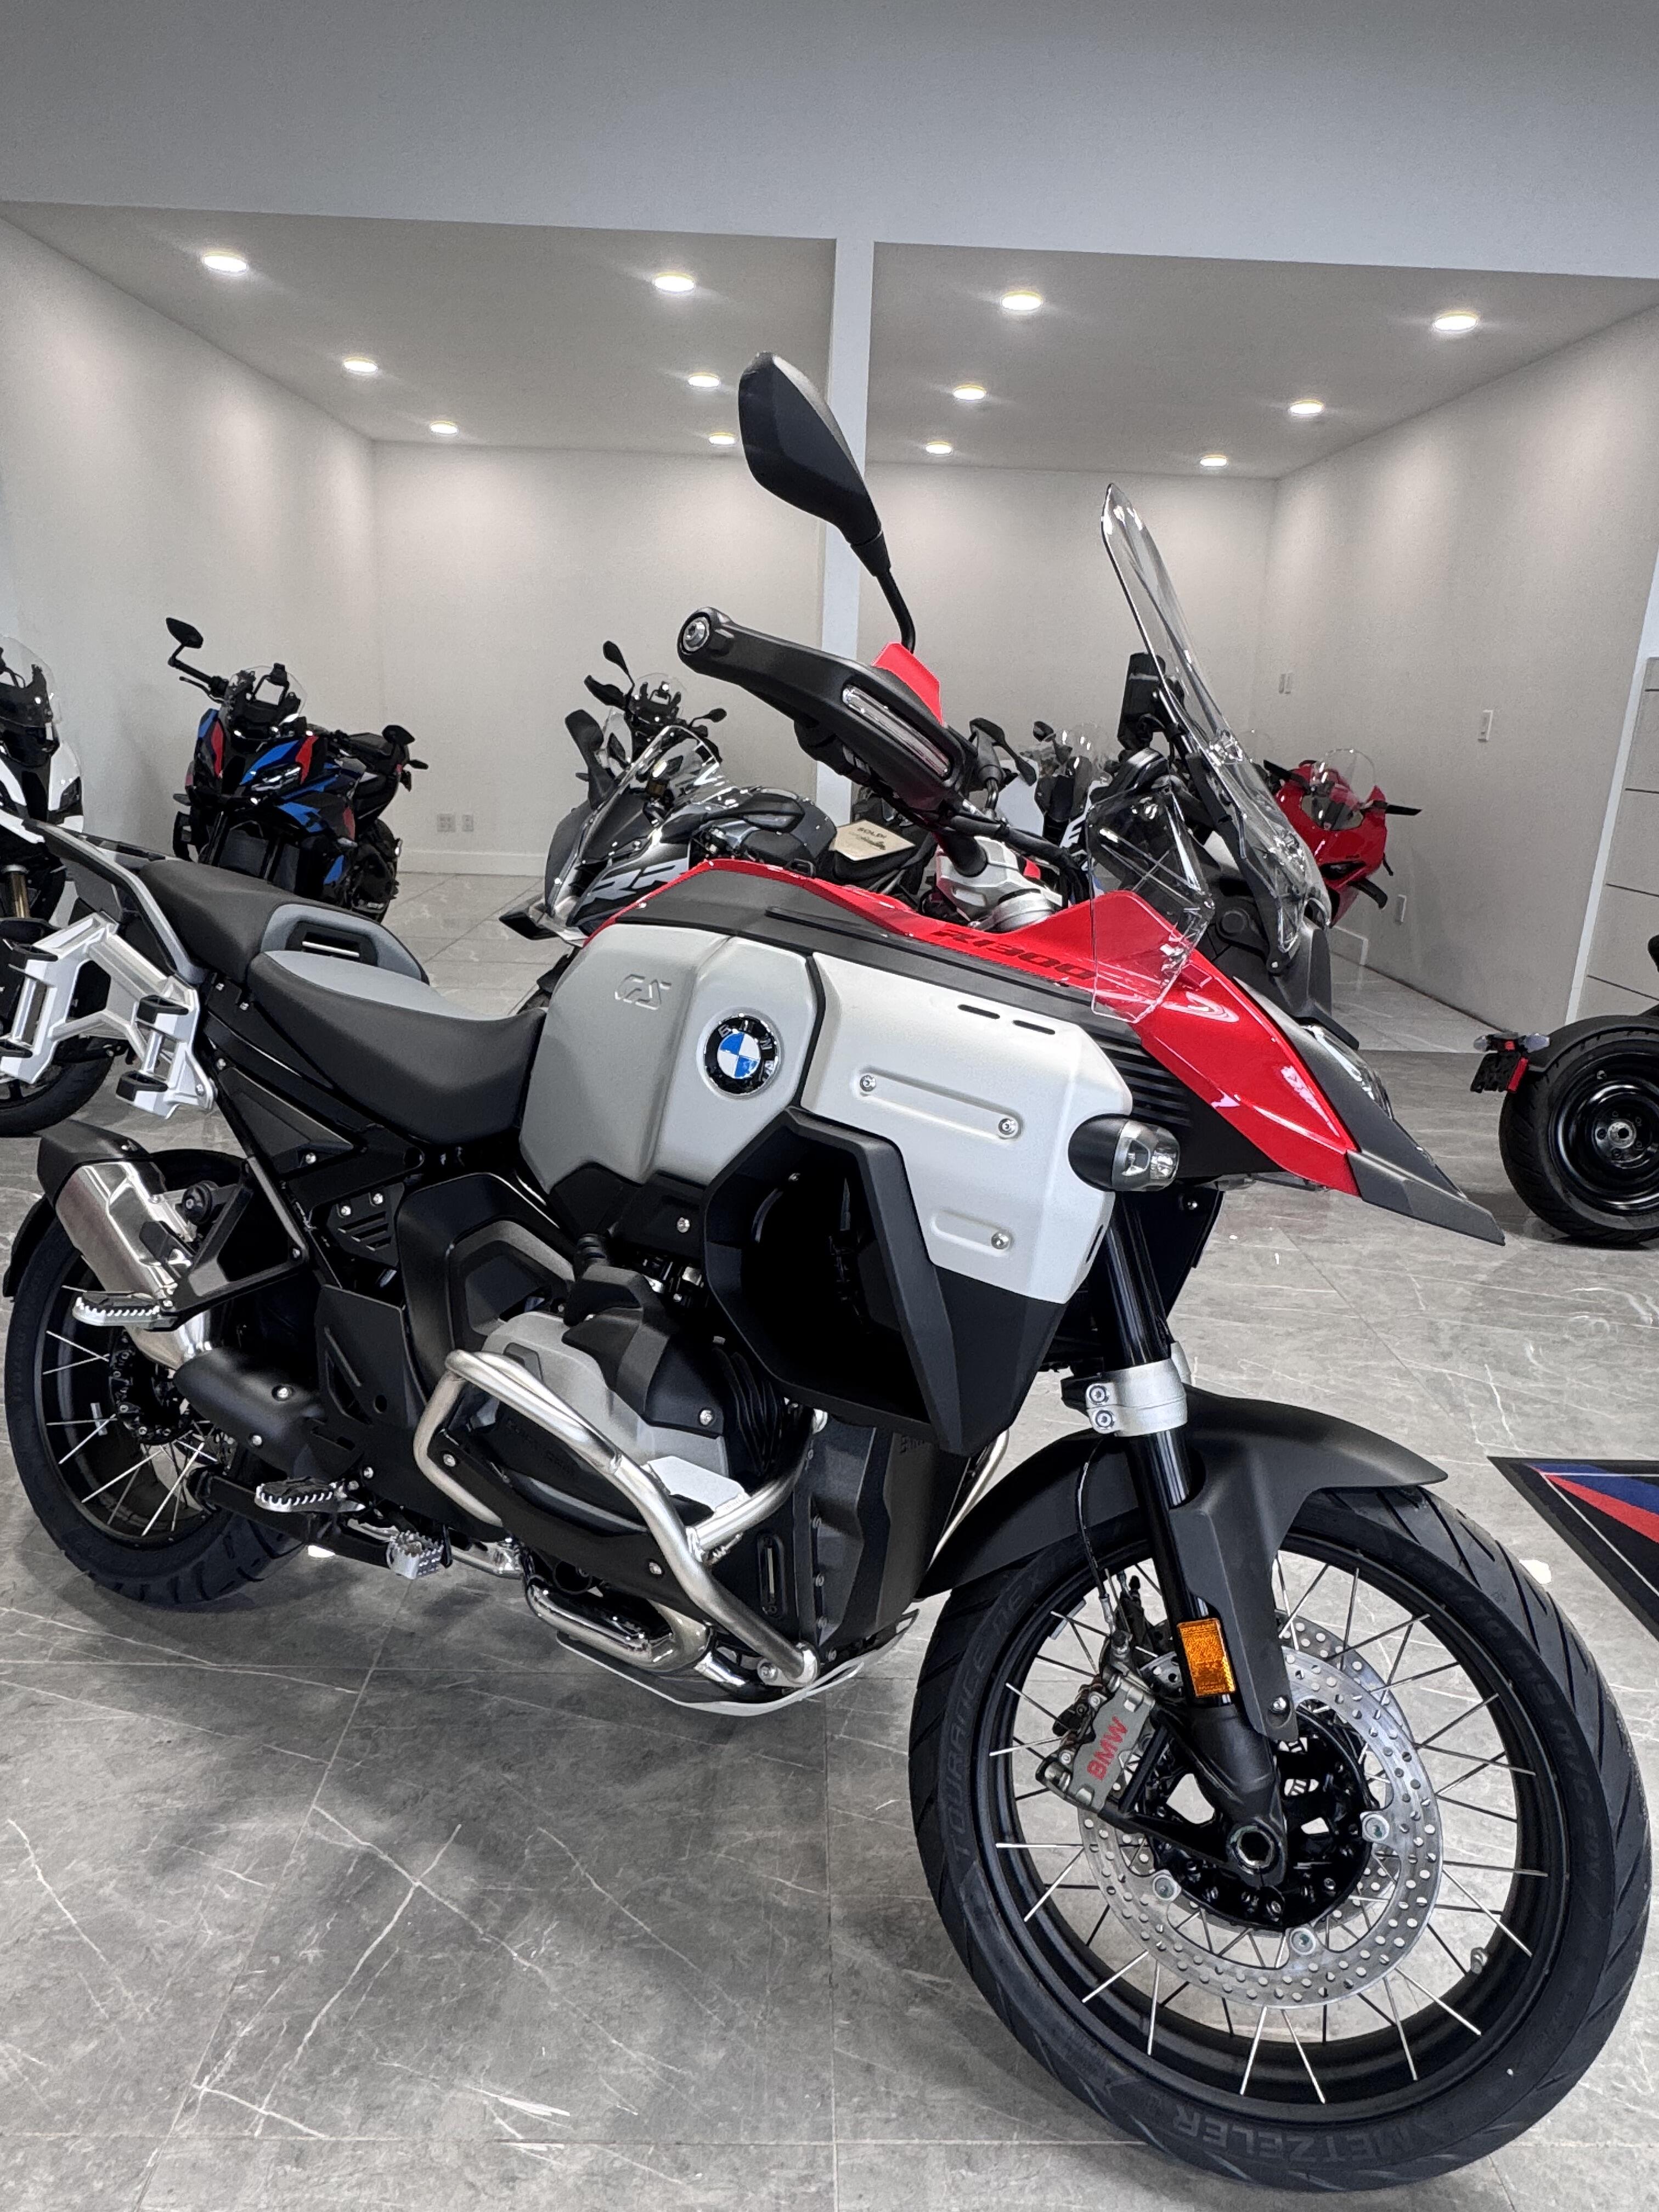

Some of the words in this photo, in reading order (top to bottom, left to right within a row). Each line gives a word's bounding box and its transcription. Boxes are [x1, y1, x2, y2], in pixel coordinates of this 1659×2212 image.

[718, 1019, 773, 1051] BMW
[1086, 1716, 1128, 1781] BMW
[1172, 2103, 1412, 2163] METZELER
